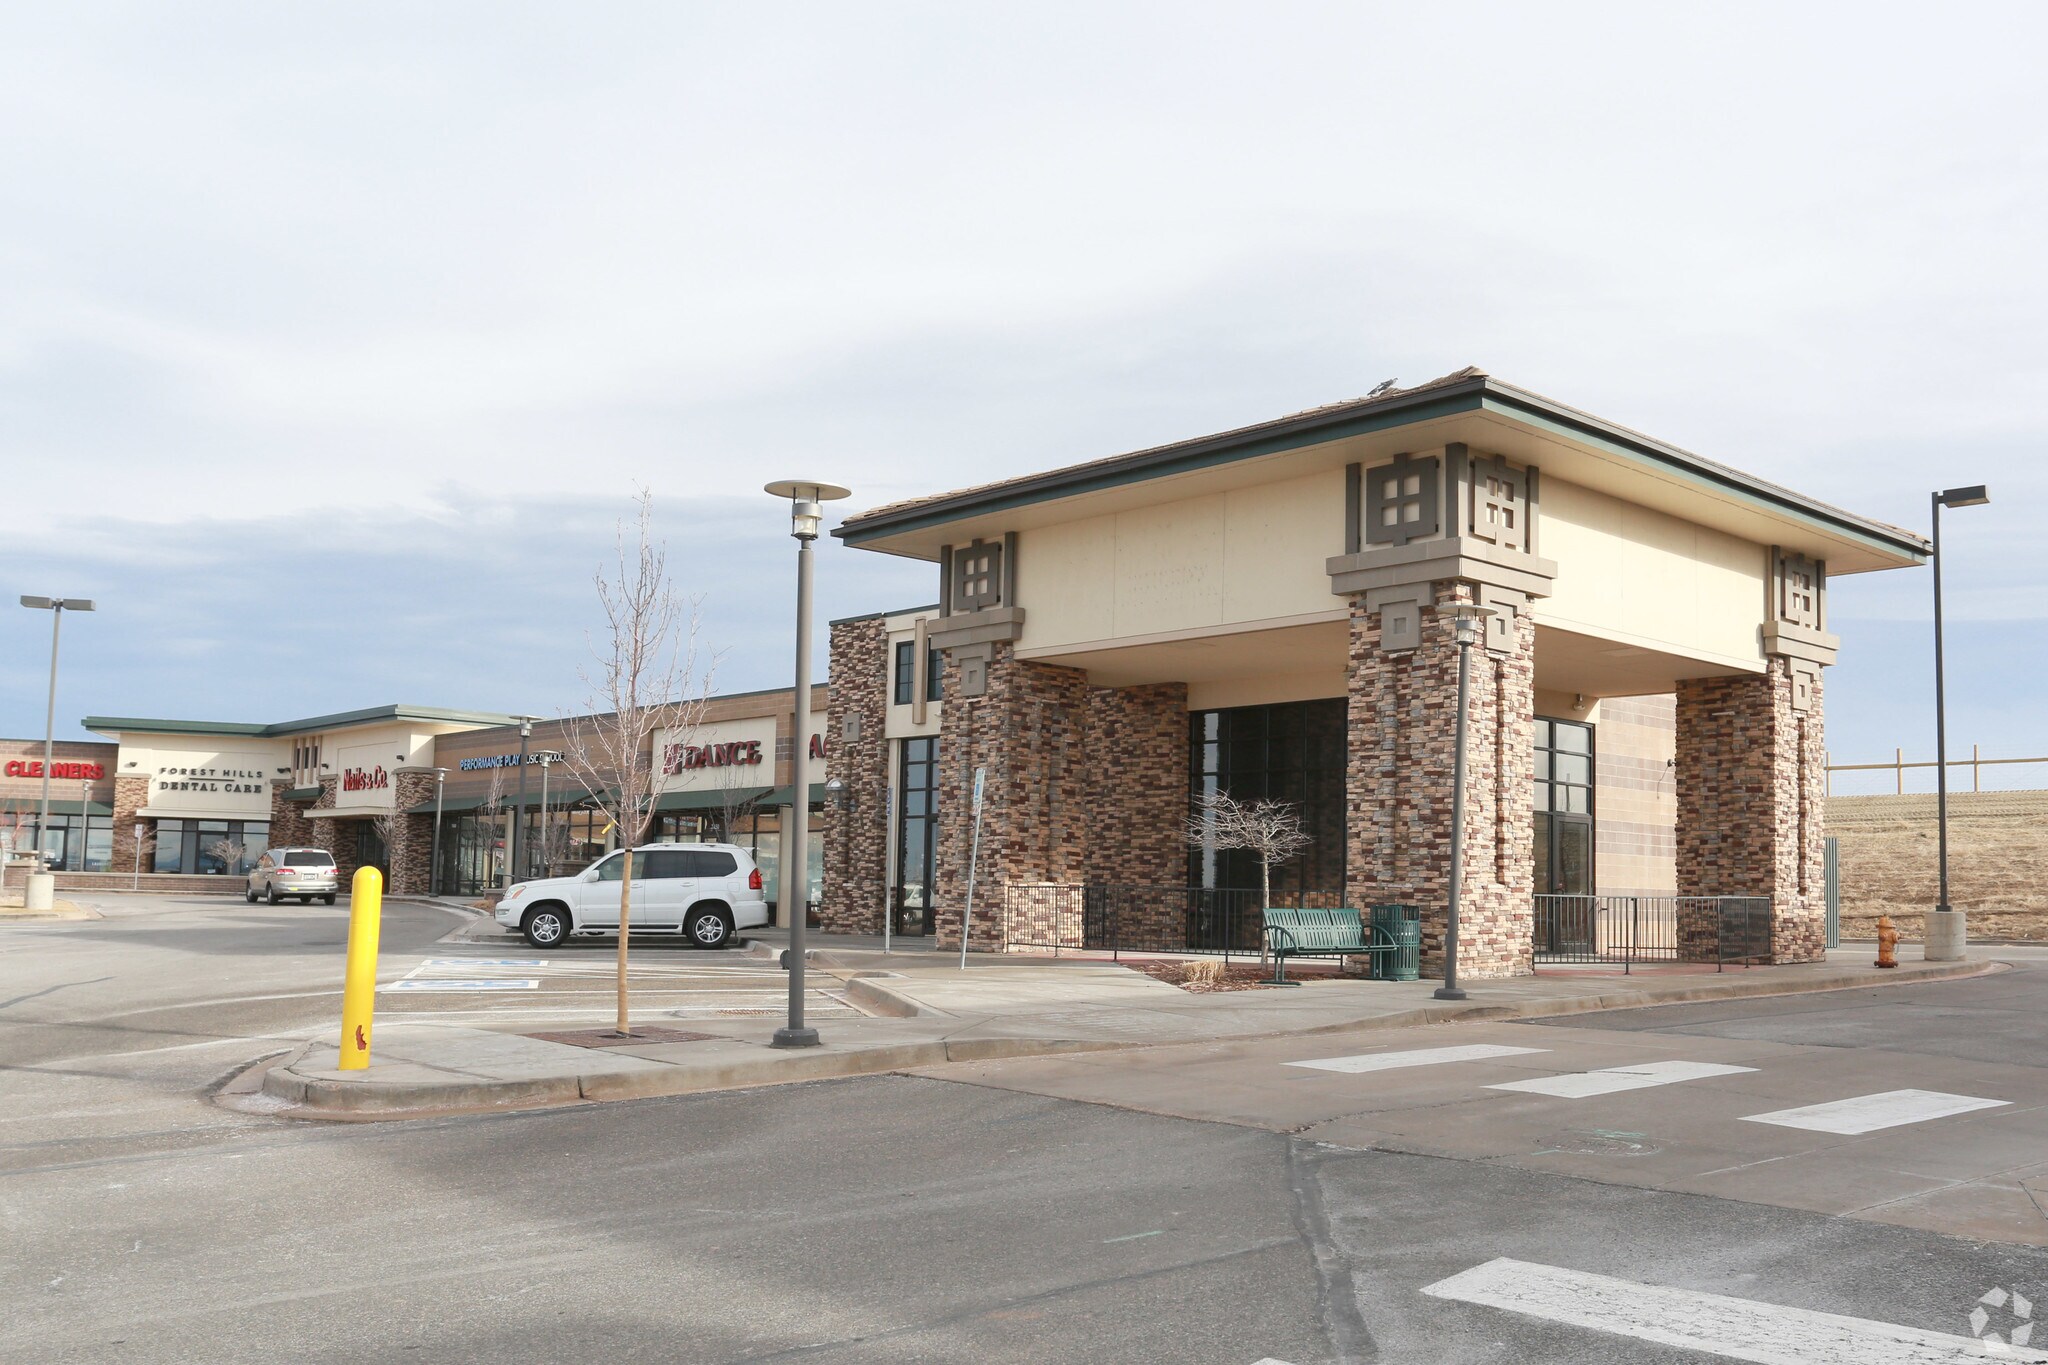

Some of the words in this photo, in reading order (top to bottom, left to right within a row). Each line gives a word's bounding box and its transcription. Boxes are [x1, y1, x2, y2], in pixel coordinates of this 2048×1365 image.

[460, 755, 504, 771] PERFORMANCE
[504, 753, 521, 767] PLAY
[539, 751, 564, 764] SOOL
[682, 740, 763, 769] DANCE
[159, 767, 216, 776] FOREST
[222, 769, 263, 778] HILLS
[344, 767, 367, 791] Nails
[367, 772, 373, 789] &
[374, 765, 388, 788] Co.
[159, 782, 218, 792] DENTAL
[224, 783, 262, 793] CARE
